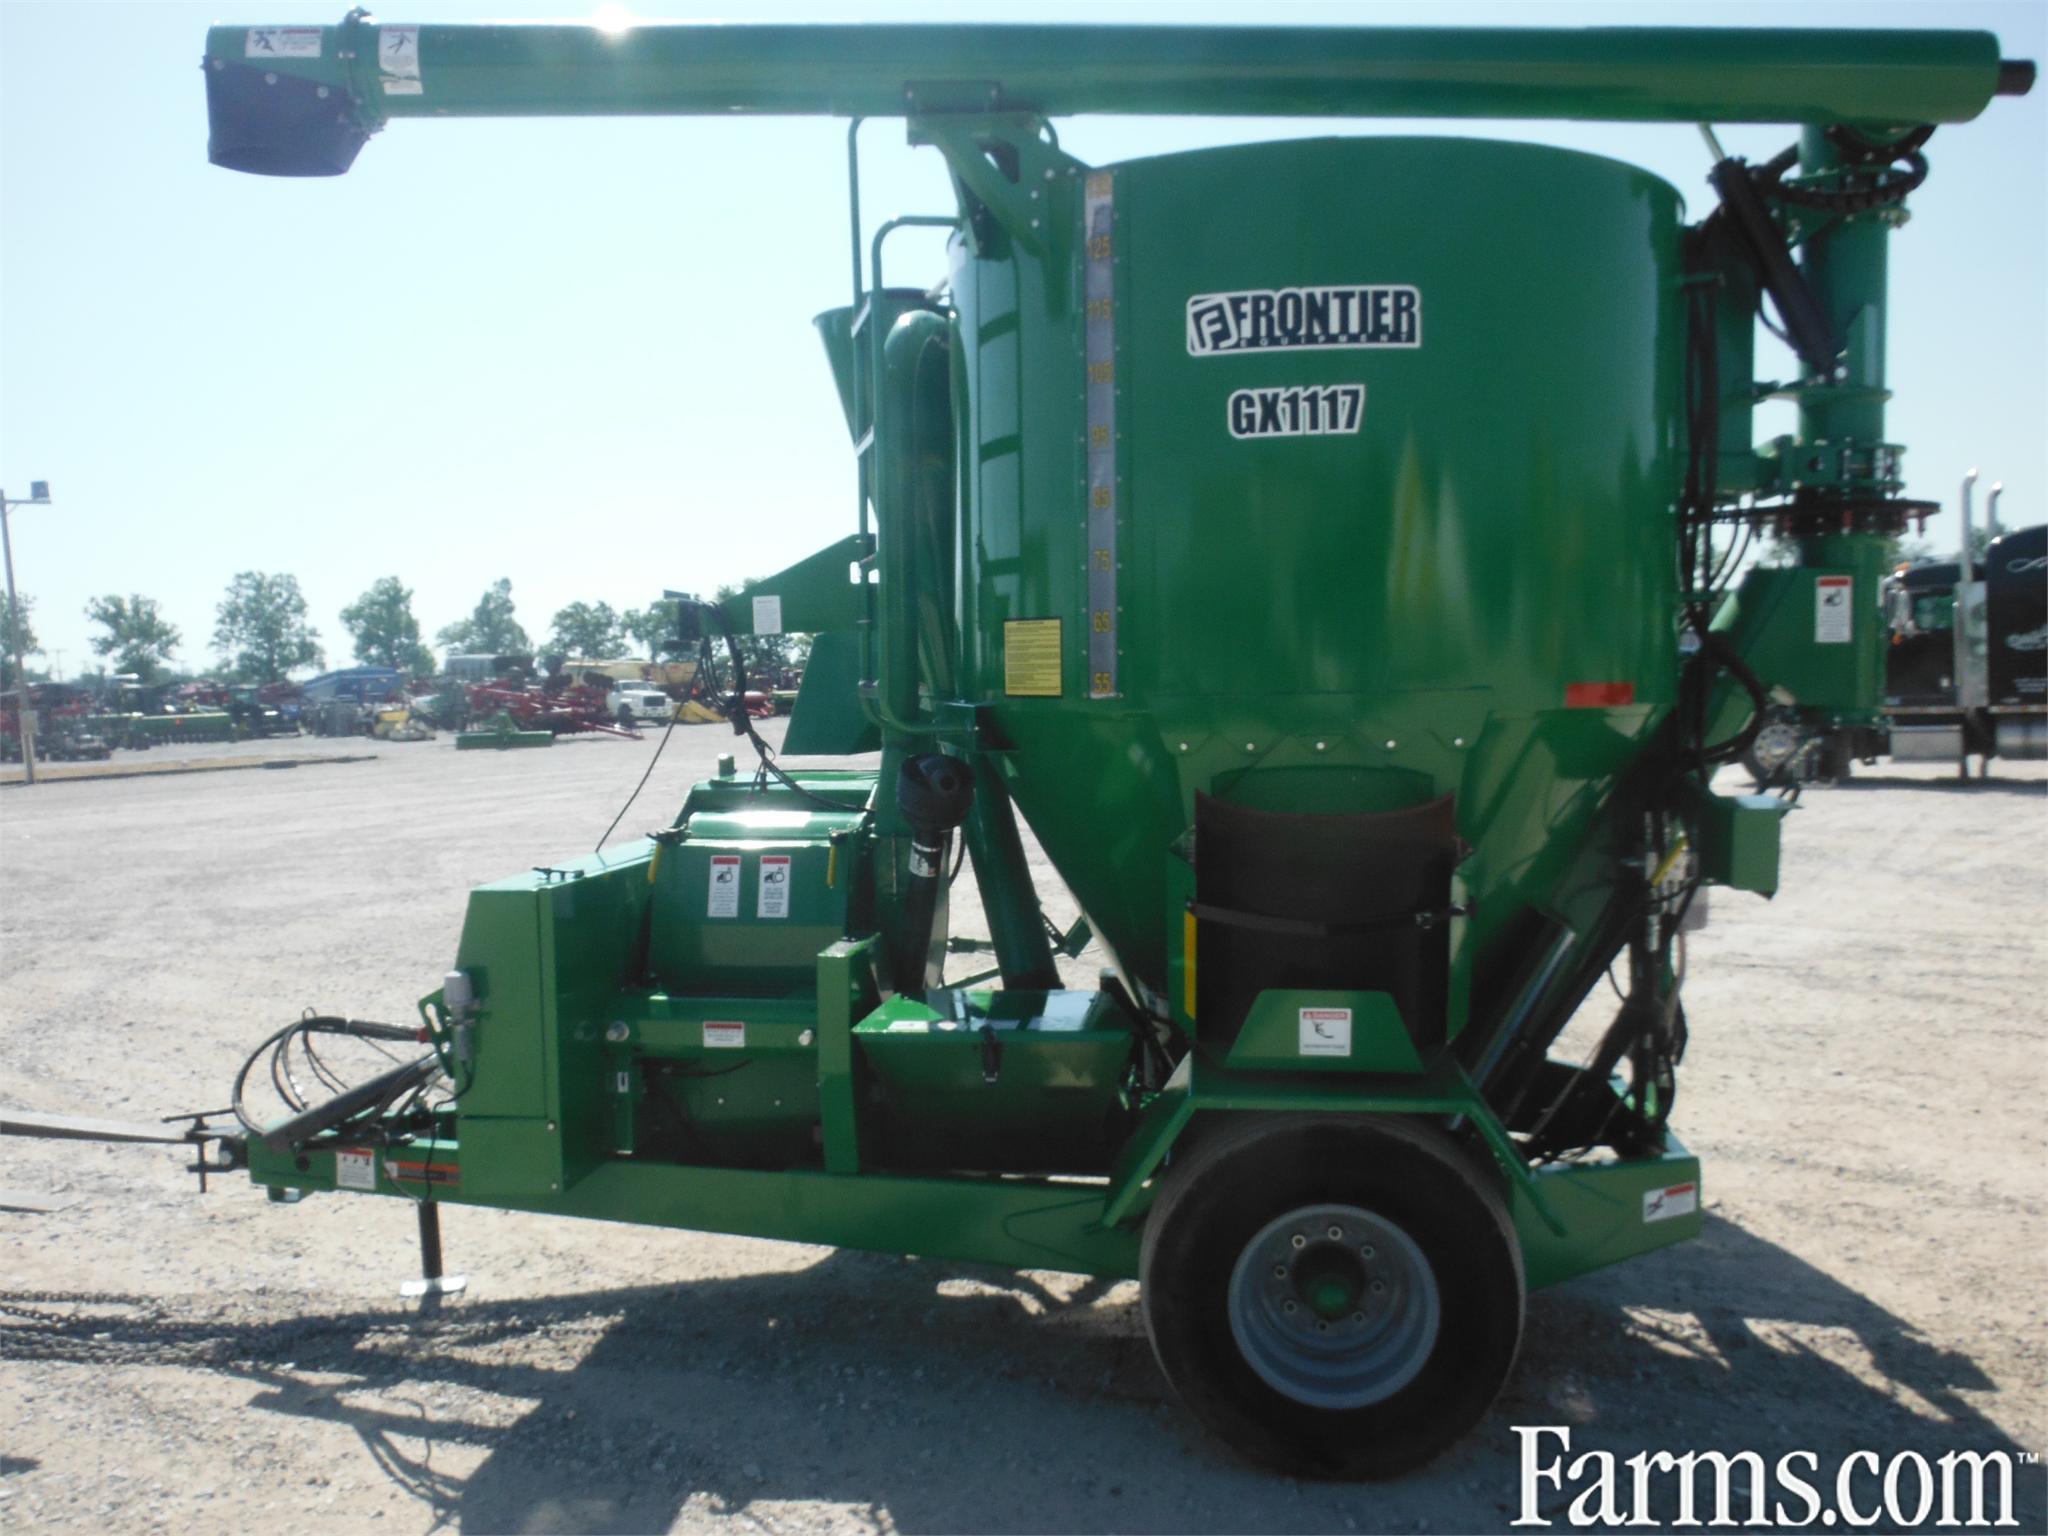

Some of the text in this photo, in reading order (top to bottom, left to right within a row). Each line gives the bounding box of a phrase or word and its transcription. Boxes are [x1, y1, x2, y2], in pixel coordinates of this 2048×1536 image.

[1231, 289, 1417, 343] FRONTIER
[1239, 333, 1408, 347] EQUIPMENT
[1231, 388, 1361, 435] GX1117
